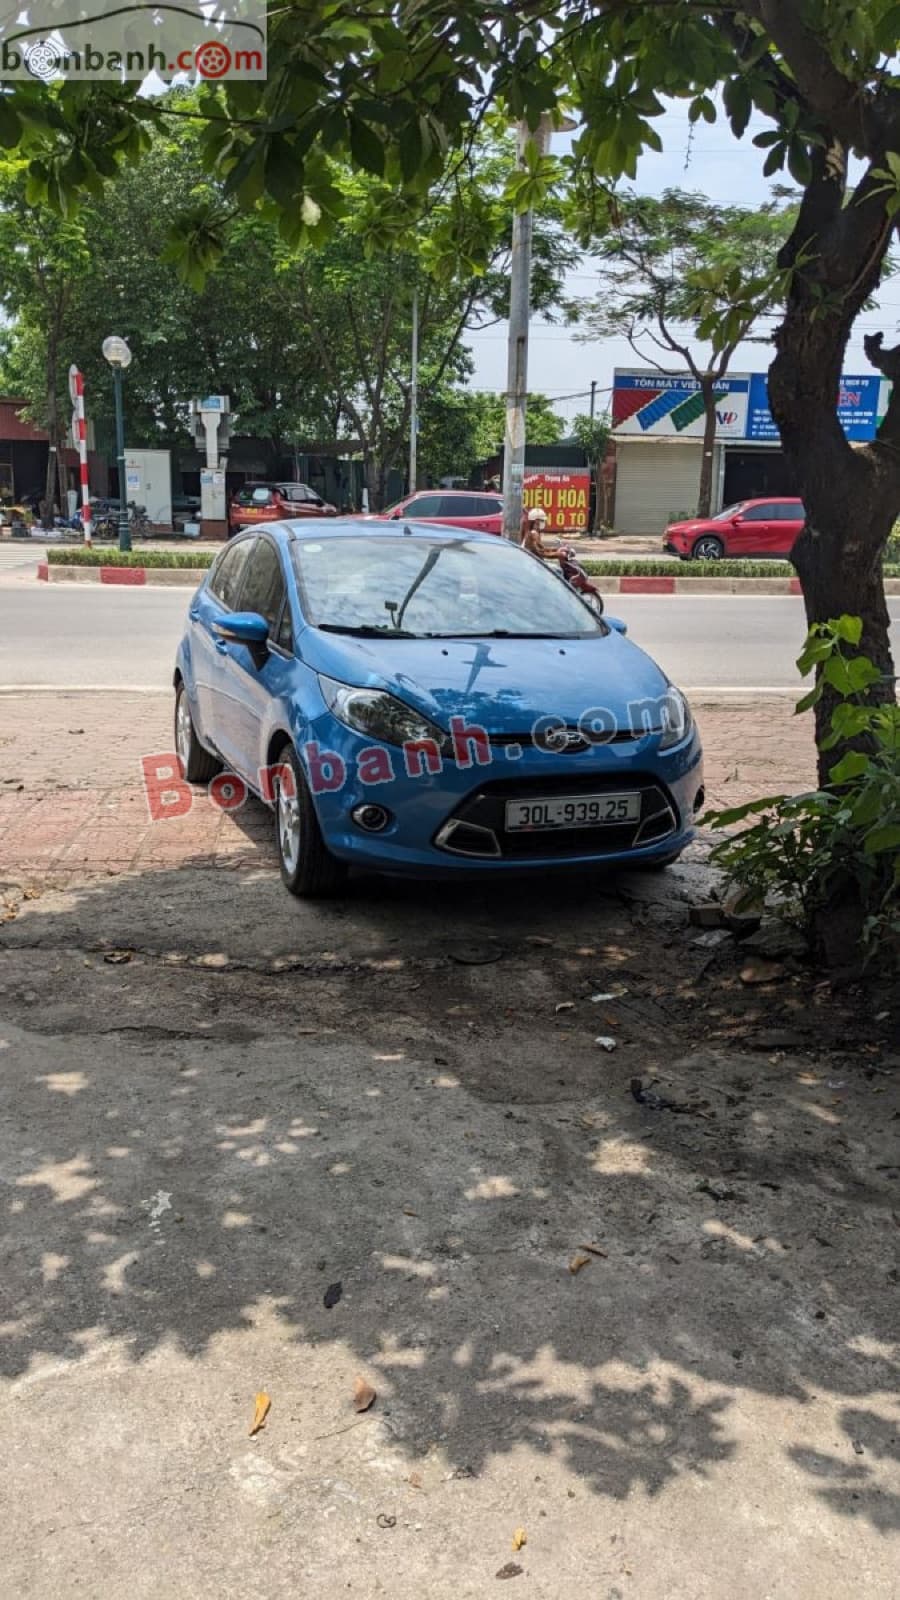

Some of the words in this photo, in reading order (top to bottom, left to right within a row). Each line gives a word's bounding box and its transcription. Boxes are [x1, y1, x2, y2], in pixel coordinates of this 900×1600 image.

[634, 377, 655, 388] TÔN
[556, 510, 565, 526] Ô
[569, 510, 586, 526] TÔ
[519, 800, 629, 825] 30L-939.25
